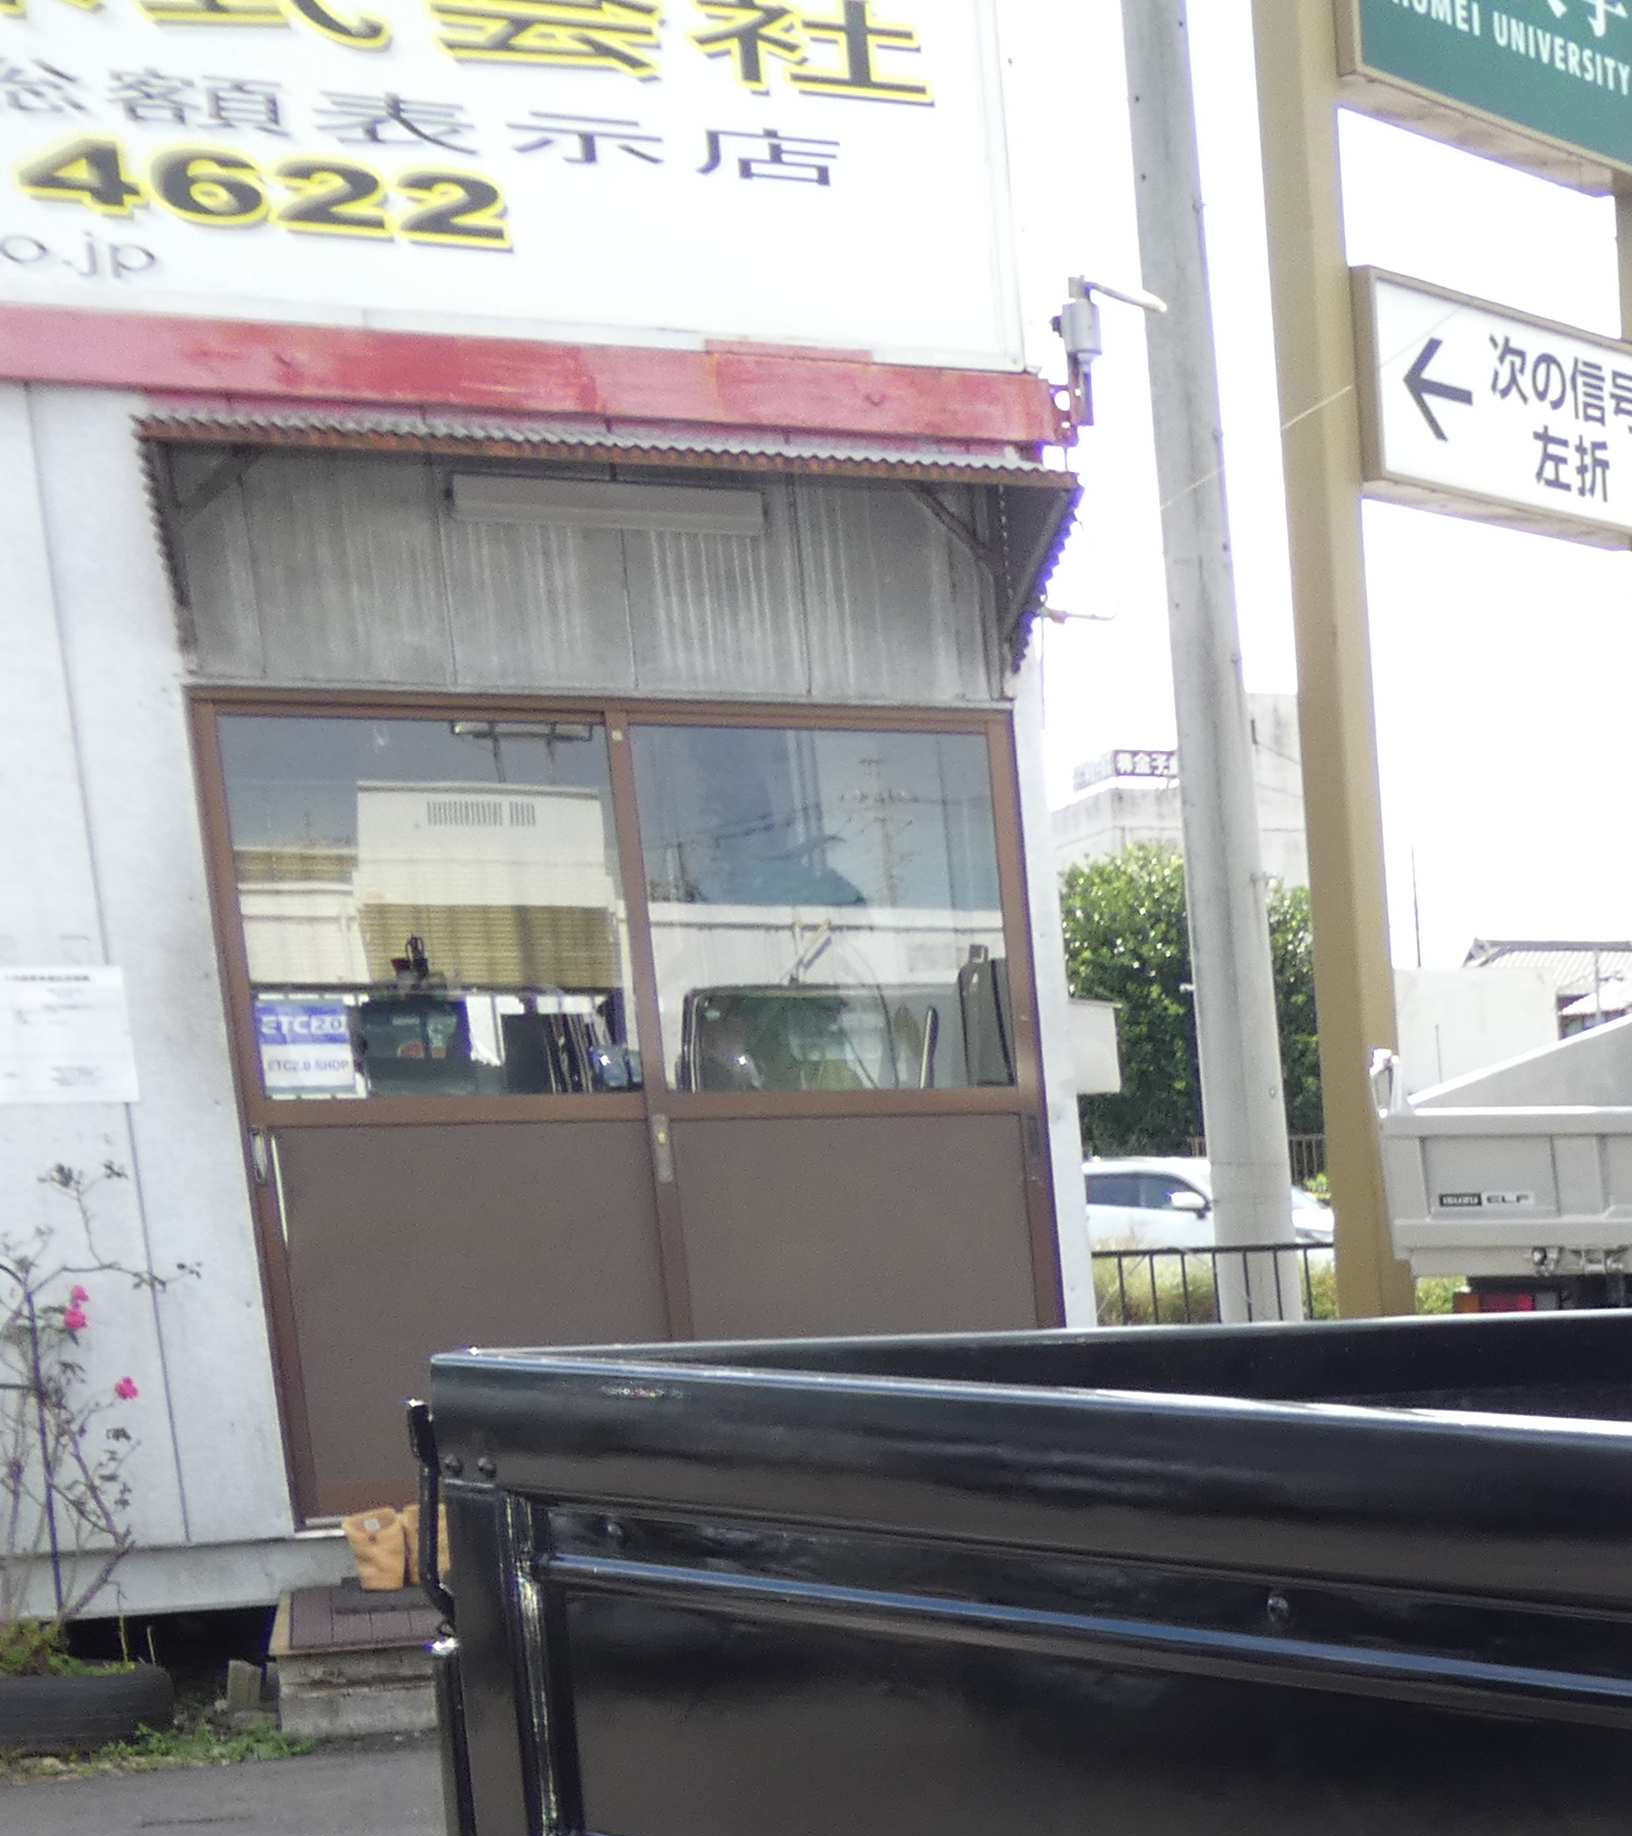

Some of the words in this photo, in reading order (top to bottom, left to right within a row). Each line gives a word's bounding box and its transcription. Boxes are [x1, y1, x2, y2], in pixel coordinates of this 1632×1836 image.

[1491, 9, 1630, 96] UNIVERSITY
[8, 132, 512, 252] 4622
[1532, 424, 1612, 503] 左折
